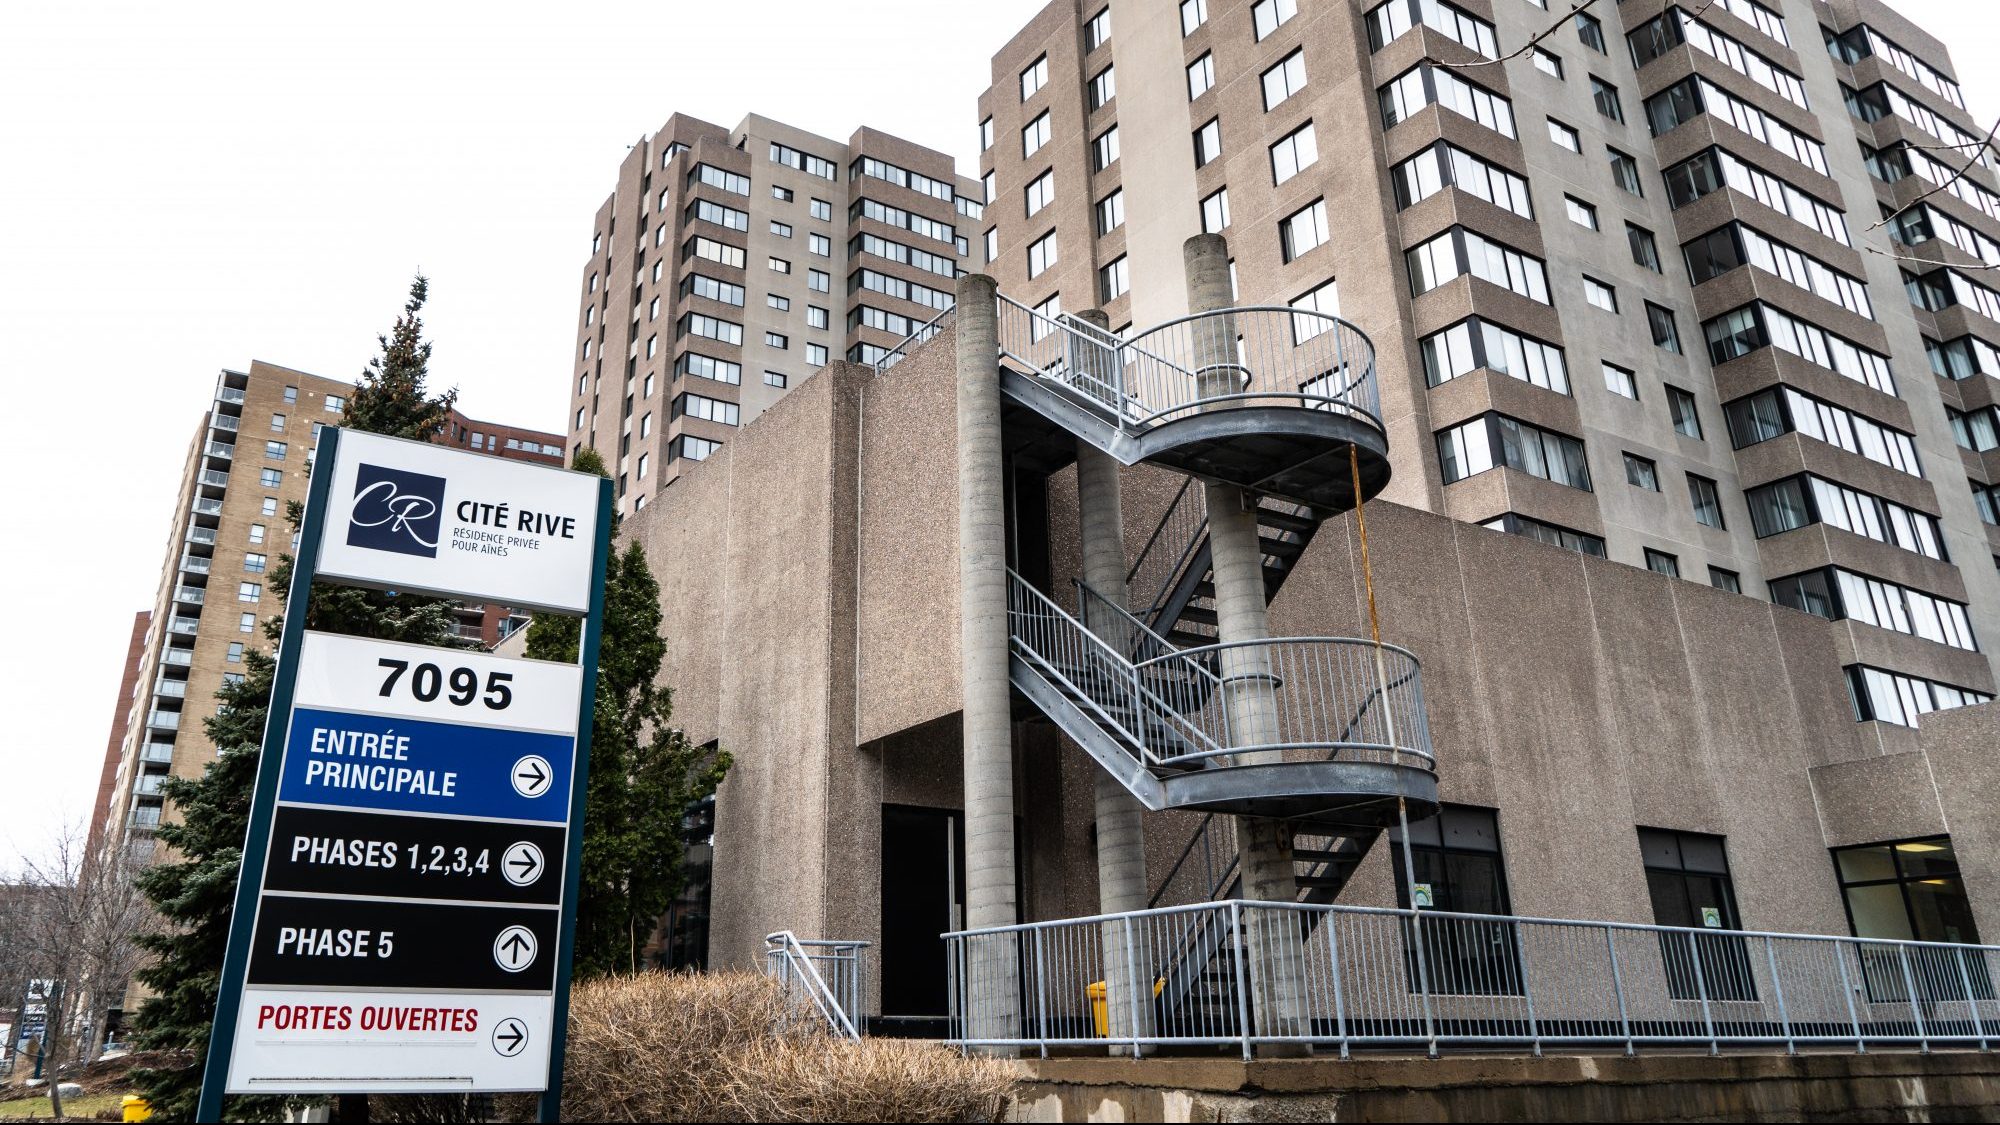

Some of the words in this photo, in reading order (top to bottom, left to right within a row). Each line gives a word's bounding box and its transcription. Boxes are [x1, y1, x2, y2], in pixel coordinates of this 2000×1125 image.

[351, 481, 438, 548] CR
[456, 501, 509, 529] CITÉ
[516, 510, 576, 540] RIVE
[451, 539, 480, 552] POUR
[481, 542, 509, 557] AÎNÉS
[453, 527, 505, 544] RÉSIDENCE
[507, 536, 540, 550] PRIVÉE
[377, 657, 514, 711] 7095
[310, 728, 410, 760] ENTRÉE
[305, 760, 458, 797] PRINCIPALE
[291, 835, 398, 868] PHASES
[407, 843, 490, 877] 1,2,3,4
[277, 927, 371, 957] PHASE
[377, 931, 394, 958] 5
[257, 1004, 353, 1031] PORTES
[359, 1006, 479, 1033] OUVERTES
